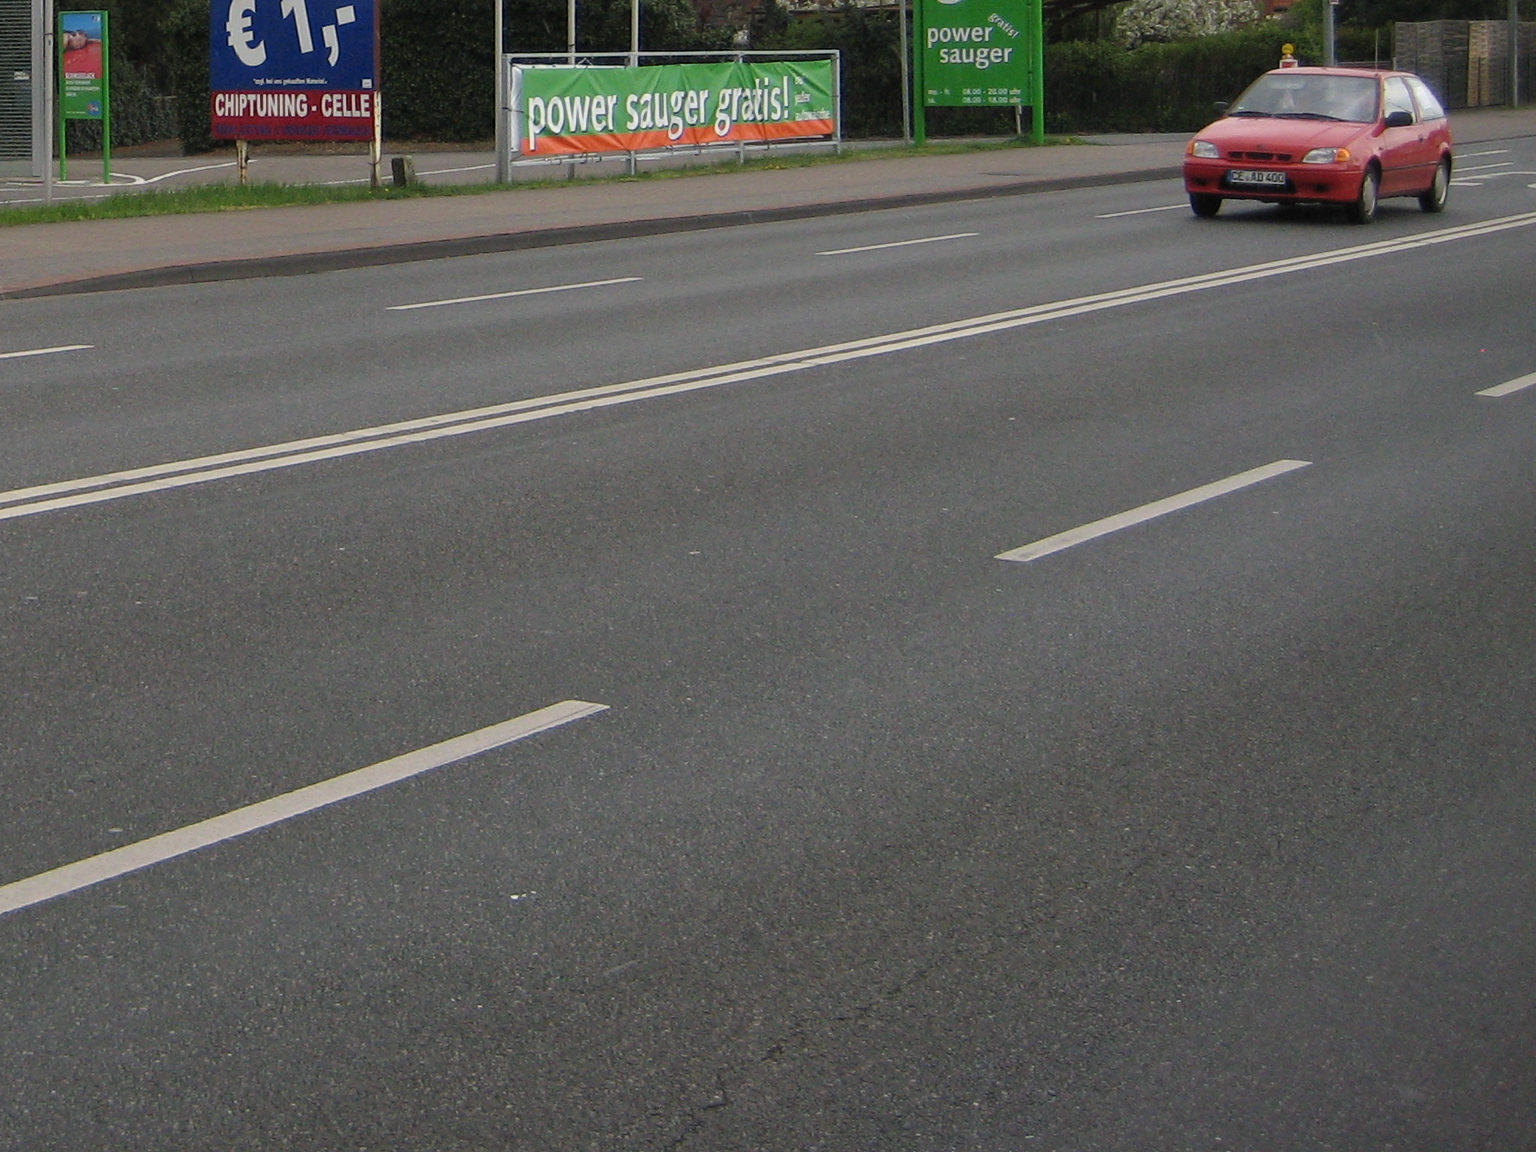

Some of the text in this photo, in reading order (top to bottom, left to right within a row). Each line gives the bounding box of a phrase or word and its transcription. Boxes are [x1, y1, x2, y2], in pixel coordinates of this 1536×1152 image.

[927, 27, 993, 49] power
[988, 13, 1020, 39] gratis!
[939, 47, 1013, 69] sauger
[215, 93, 308, 118] CHIPTUNING
[321, 93, 371, 118] CELLE
[527, 75, 790, 151] power sauger gratis!
